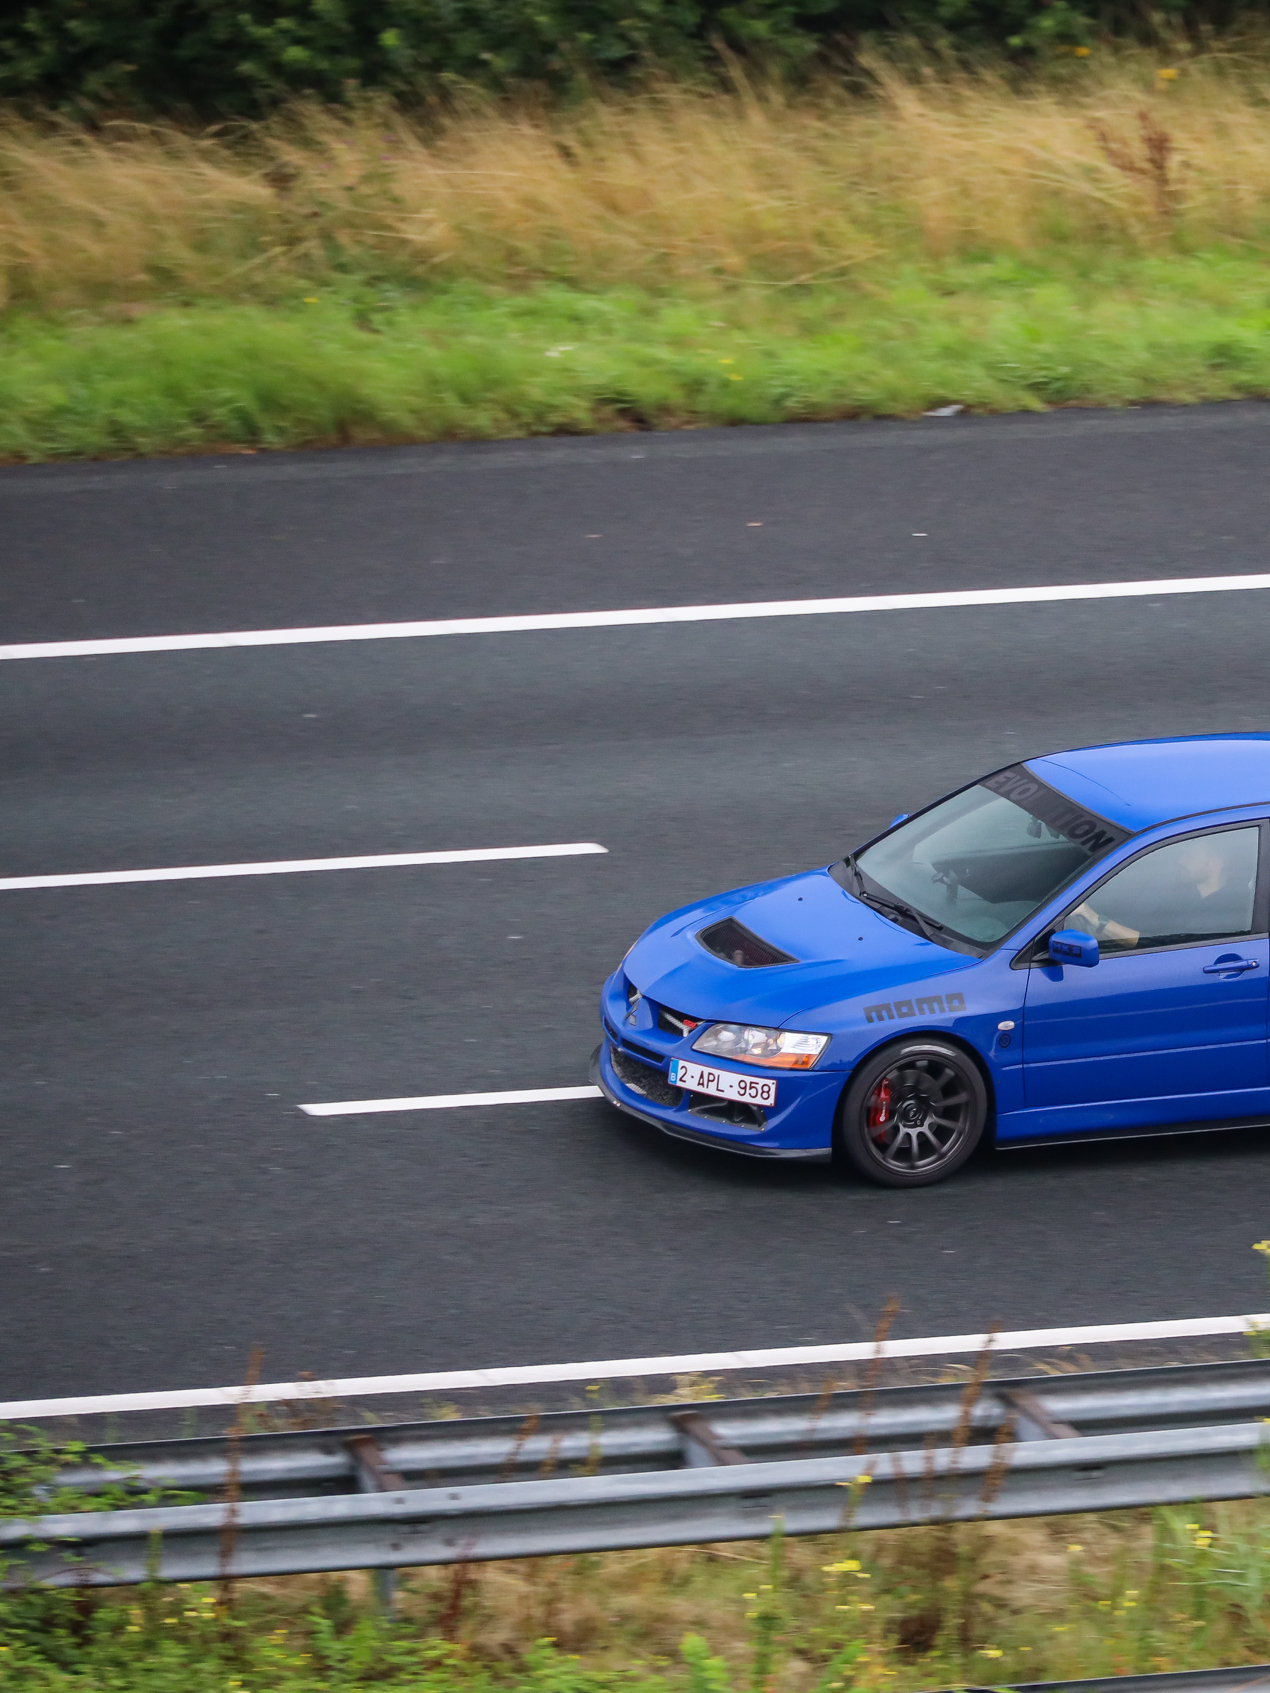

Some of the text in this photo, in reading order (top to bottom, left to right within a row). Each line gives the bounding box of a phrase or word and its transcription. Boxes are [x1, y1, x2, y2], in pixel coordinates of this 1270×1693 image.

[984, 771, 1116, 853] EVOLTION
[670, 1065, 771, 1101] B 2-APL-958
